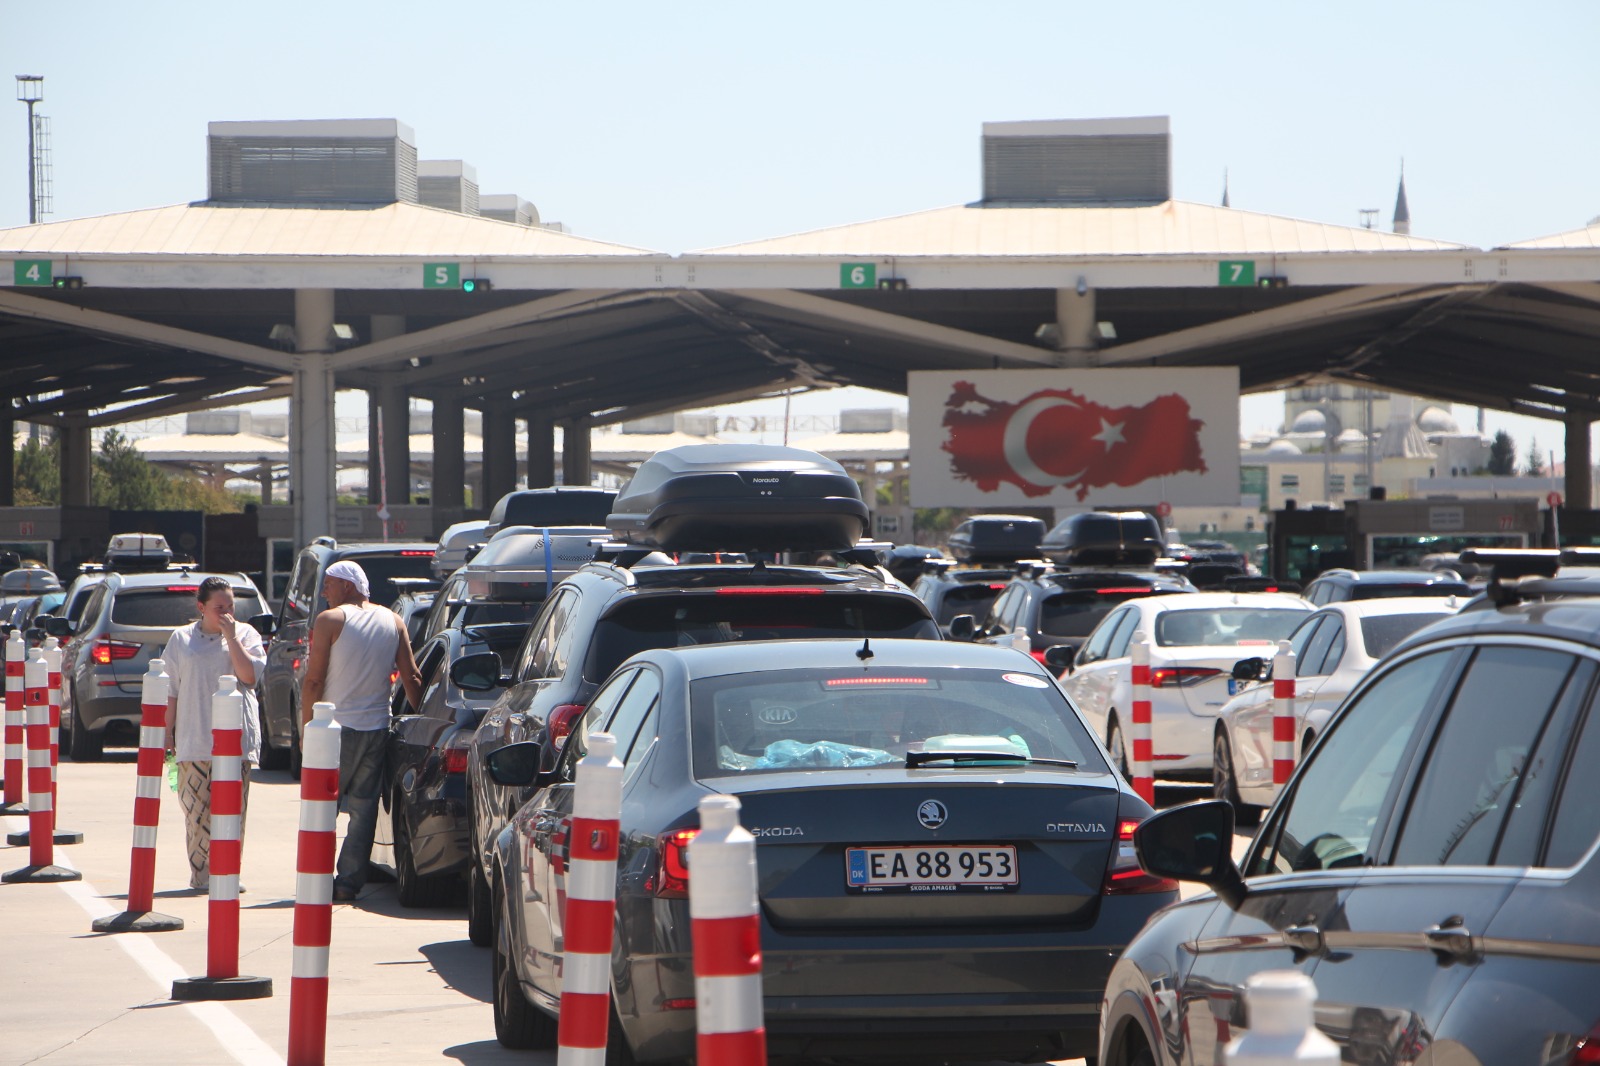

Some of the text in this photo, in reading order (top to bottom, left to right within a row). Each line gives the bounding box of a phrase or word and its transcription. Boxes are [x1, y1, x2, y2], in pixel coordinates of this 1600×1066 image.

[26, 264, 40, 281] 4
[435, 266, 449, 284] 5
[851, 266, 865, 284] 6
[1231, 264, 1243, 282] 7
[765, 709, 792, 721] KIA
[1046, 823, 1107, 833] OCTAVIA
[870, 851, 1012, 879] EA 88 953
[852, 870, 865, 878] DK
